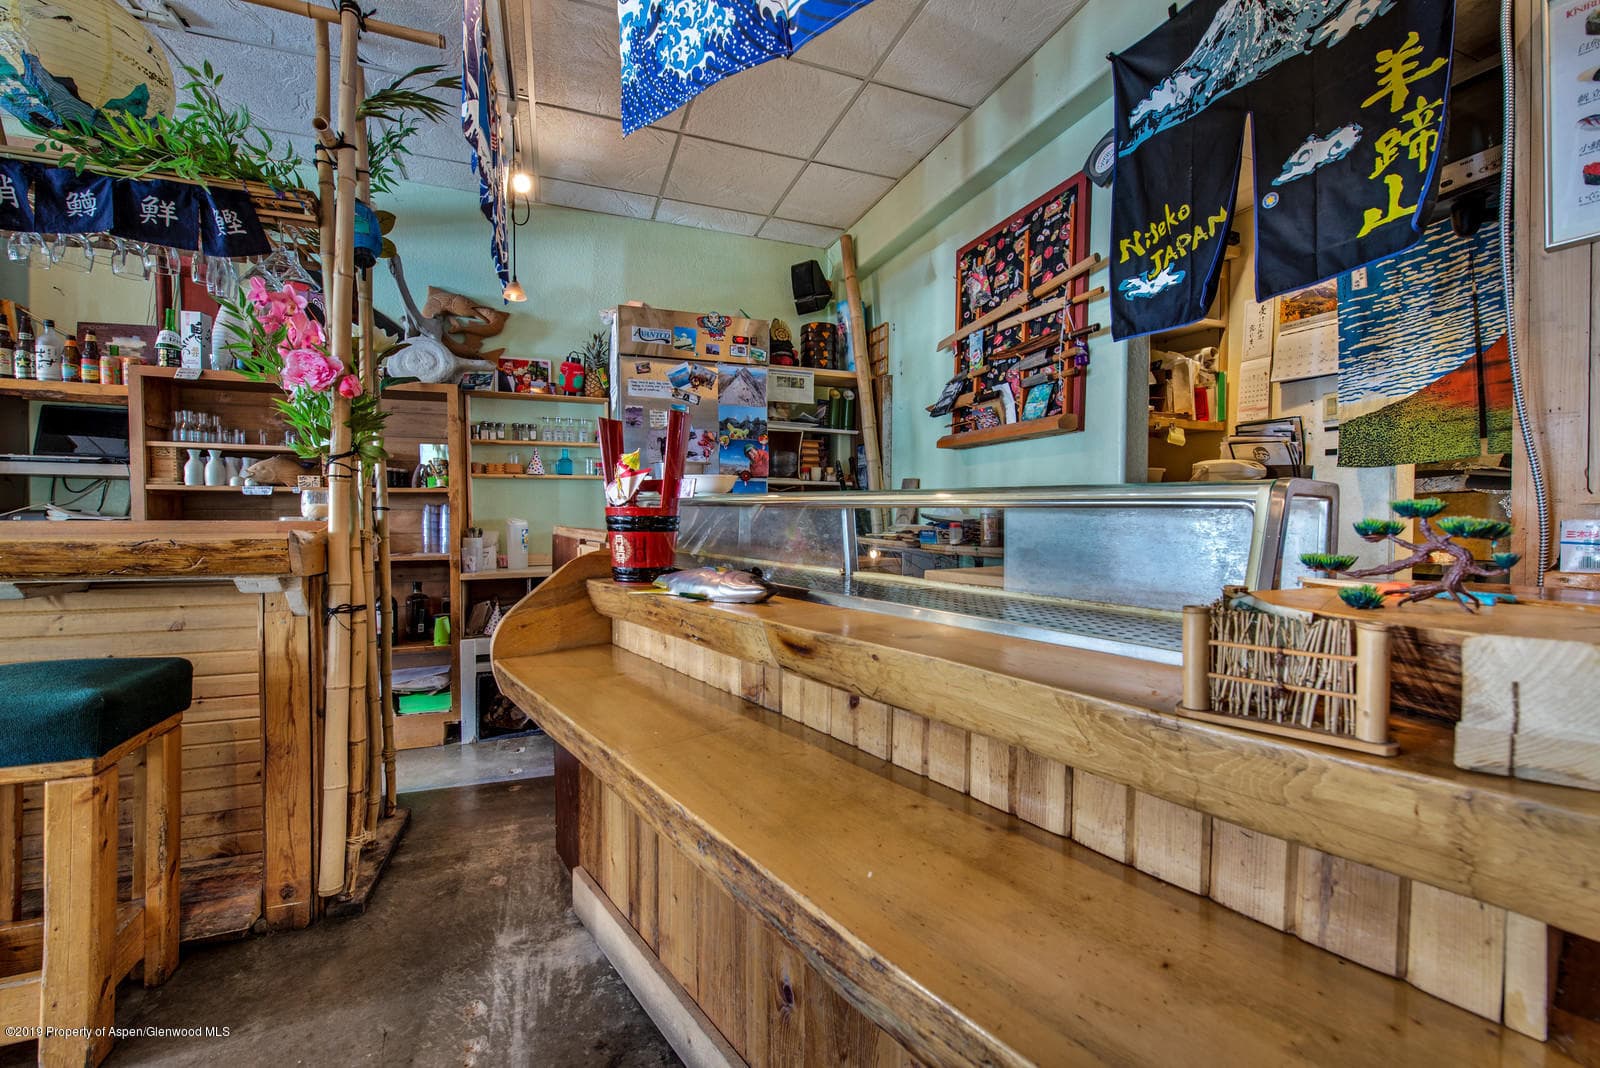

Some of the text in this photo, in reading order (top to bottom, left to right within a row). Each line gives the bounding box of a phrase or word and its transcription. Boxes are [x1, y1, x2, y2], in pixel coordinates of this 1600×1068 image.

[66, 189, 97, 218] 鱒
[139, 194, 180, 228] 鮮
[1119, 203, 1191, 264] Niseko
[1148, 206, 1227, 280] JAPAN
